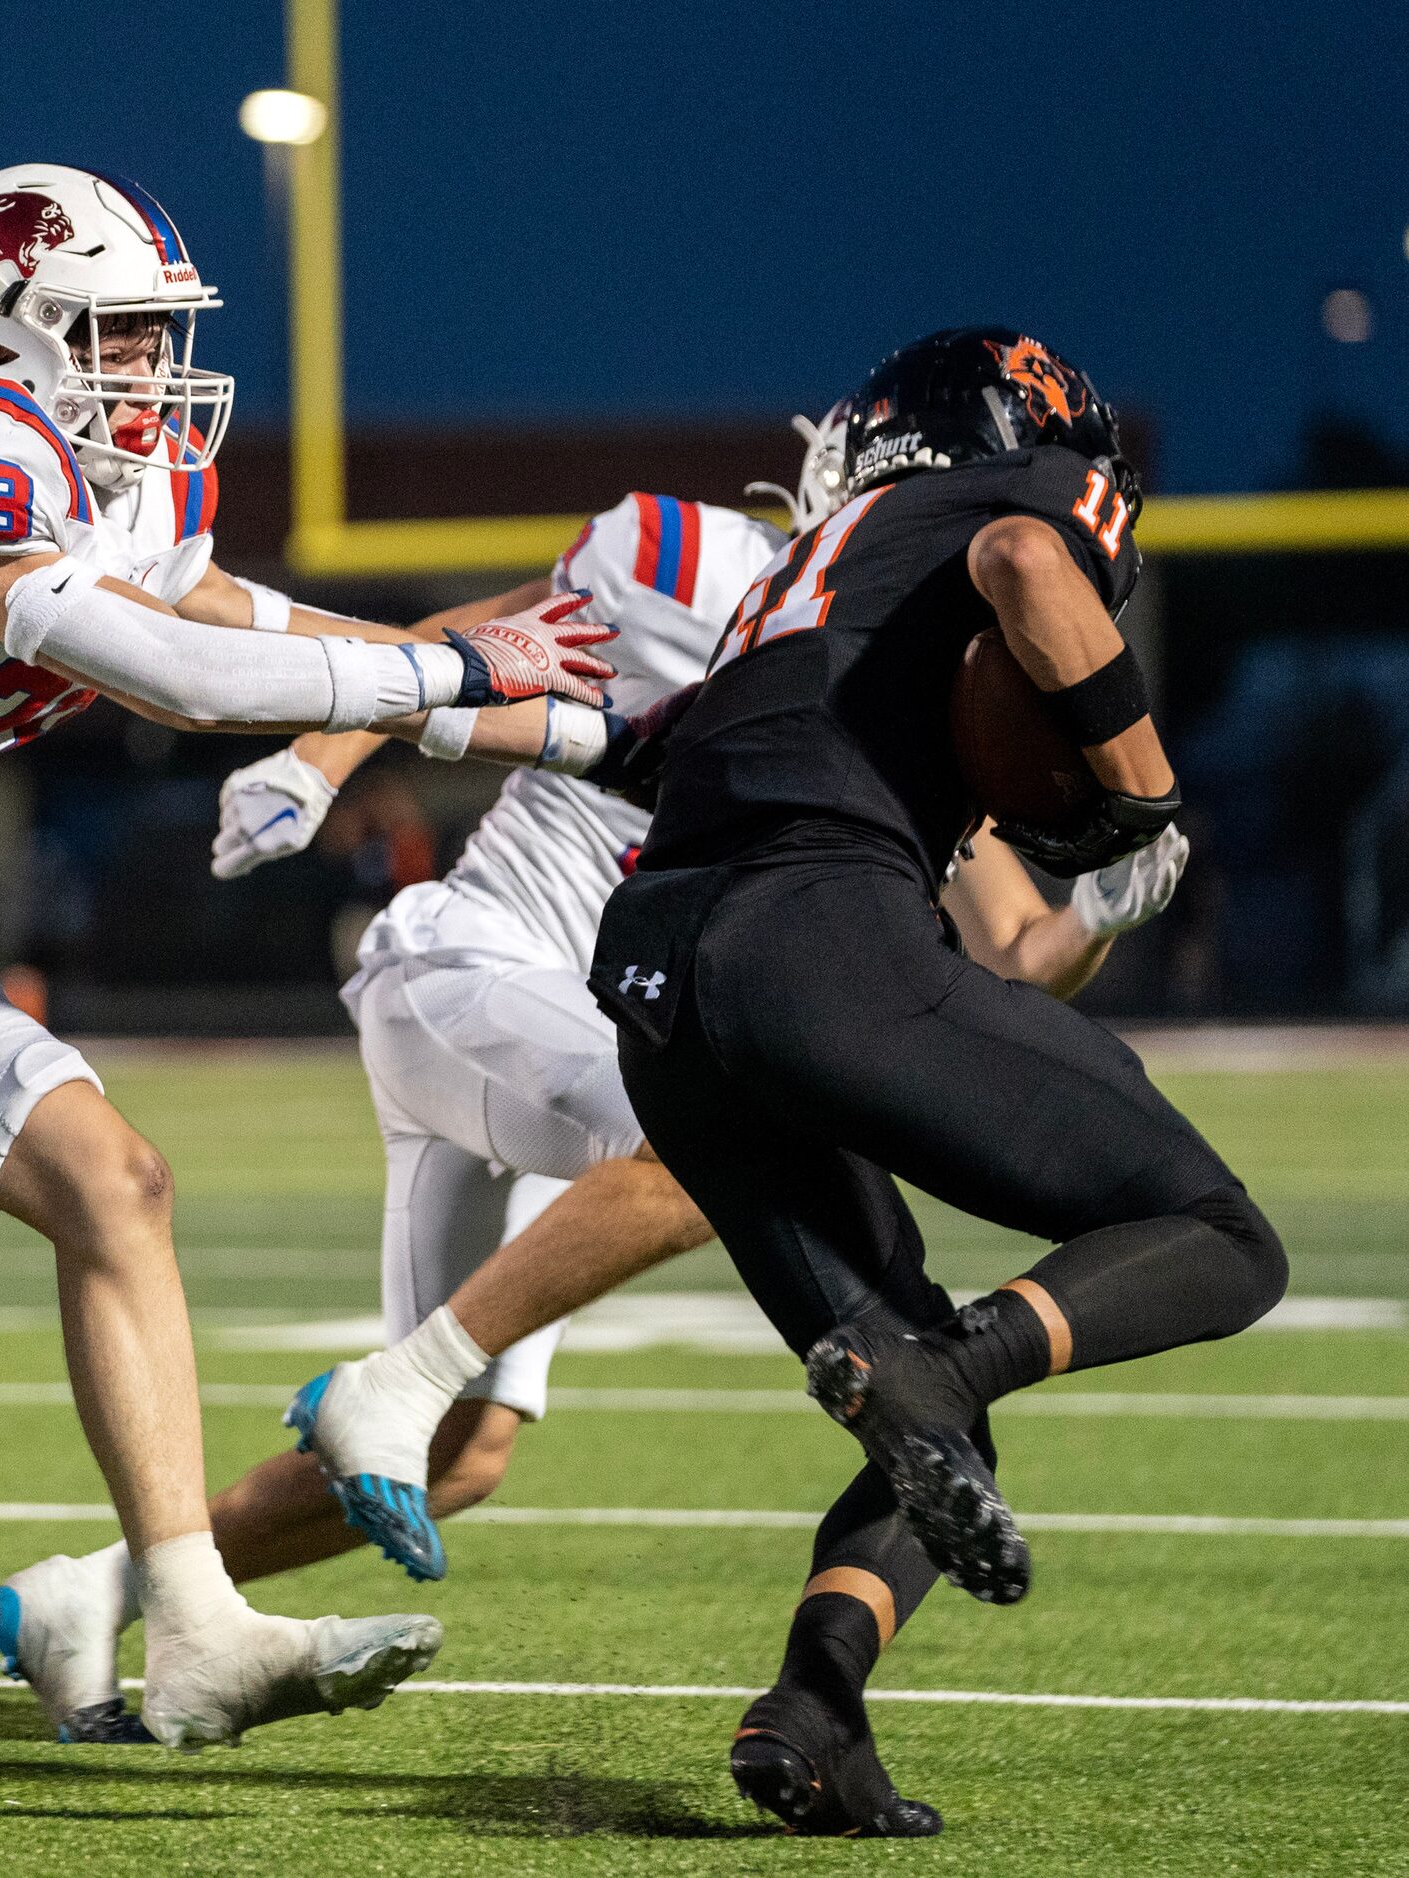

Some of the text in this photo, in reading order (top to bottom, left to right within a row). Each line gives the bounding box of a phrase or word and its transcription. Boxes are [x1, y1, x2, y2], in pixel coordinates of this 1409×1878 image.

[163, 267, 197, 283] Riddel
[1072, 469, 1128, 560] 11
[705, 483, 896, 681] 11
